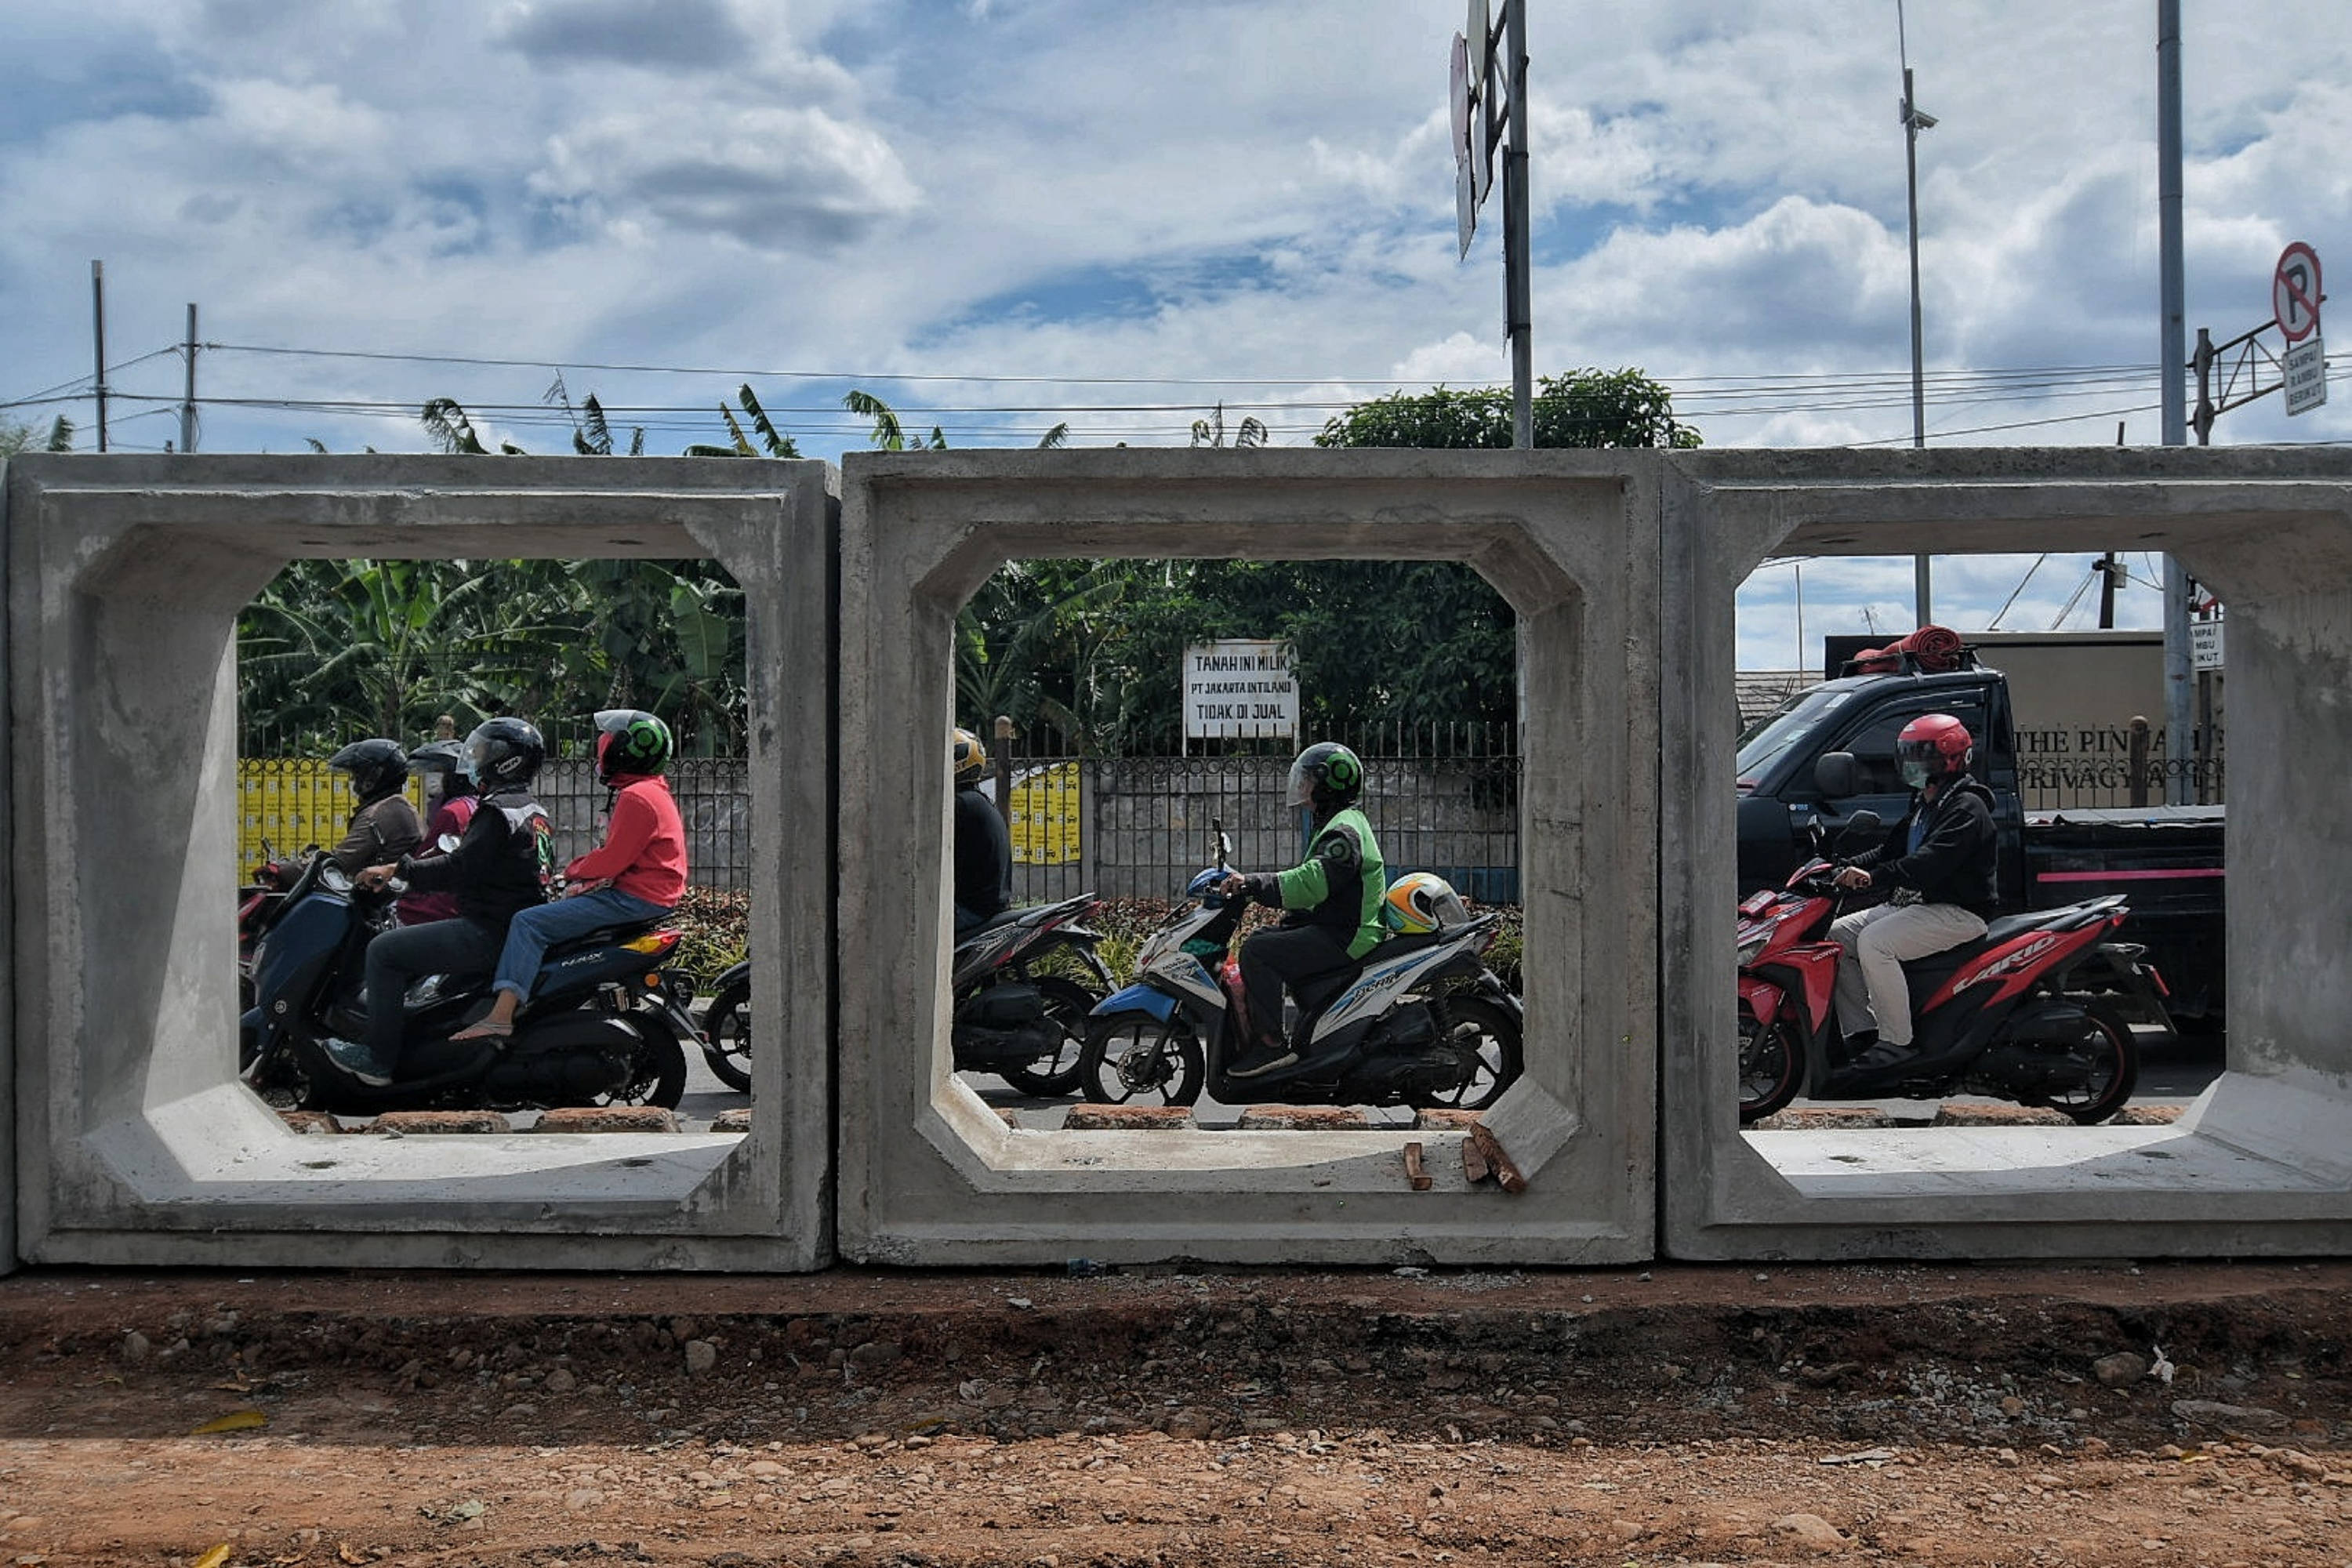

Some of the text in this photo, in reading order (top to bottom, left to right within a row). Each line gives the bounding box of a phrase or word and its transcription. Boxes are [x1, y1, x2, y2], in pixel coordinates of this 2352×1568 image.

[1196, 656, 1287, 672] TANAH INI MILIK
[1192, 681, 1291, 694] PT JAKARTA INTILAND
[1196, 704, 1286, 719] TIDAK DI JUAL
[2013, 731, 2069, 753] THE
[1953, 935, 2055, 995] VARIO
